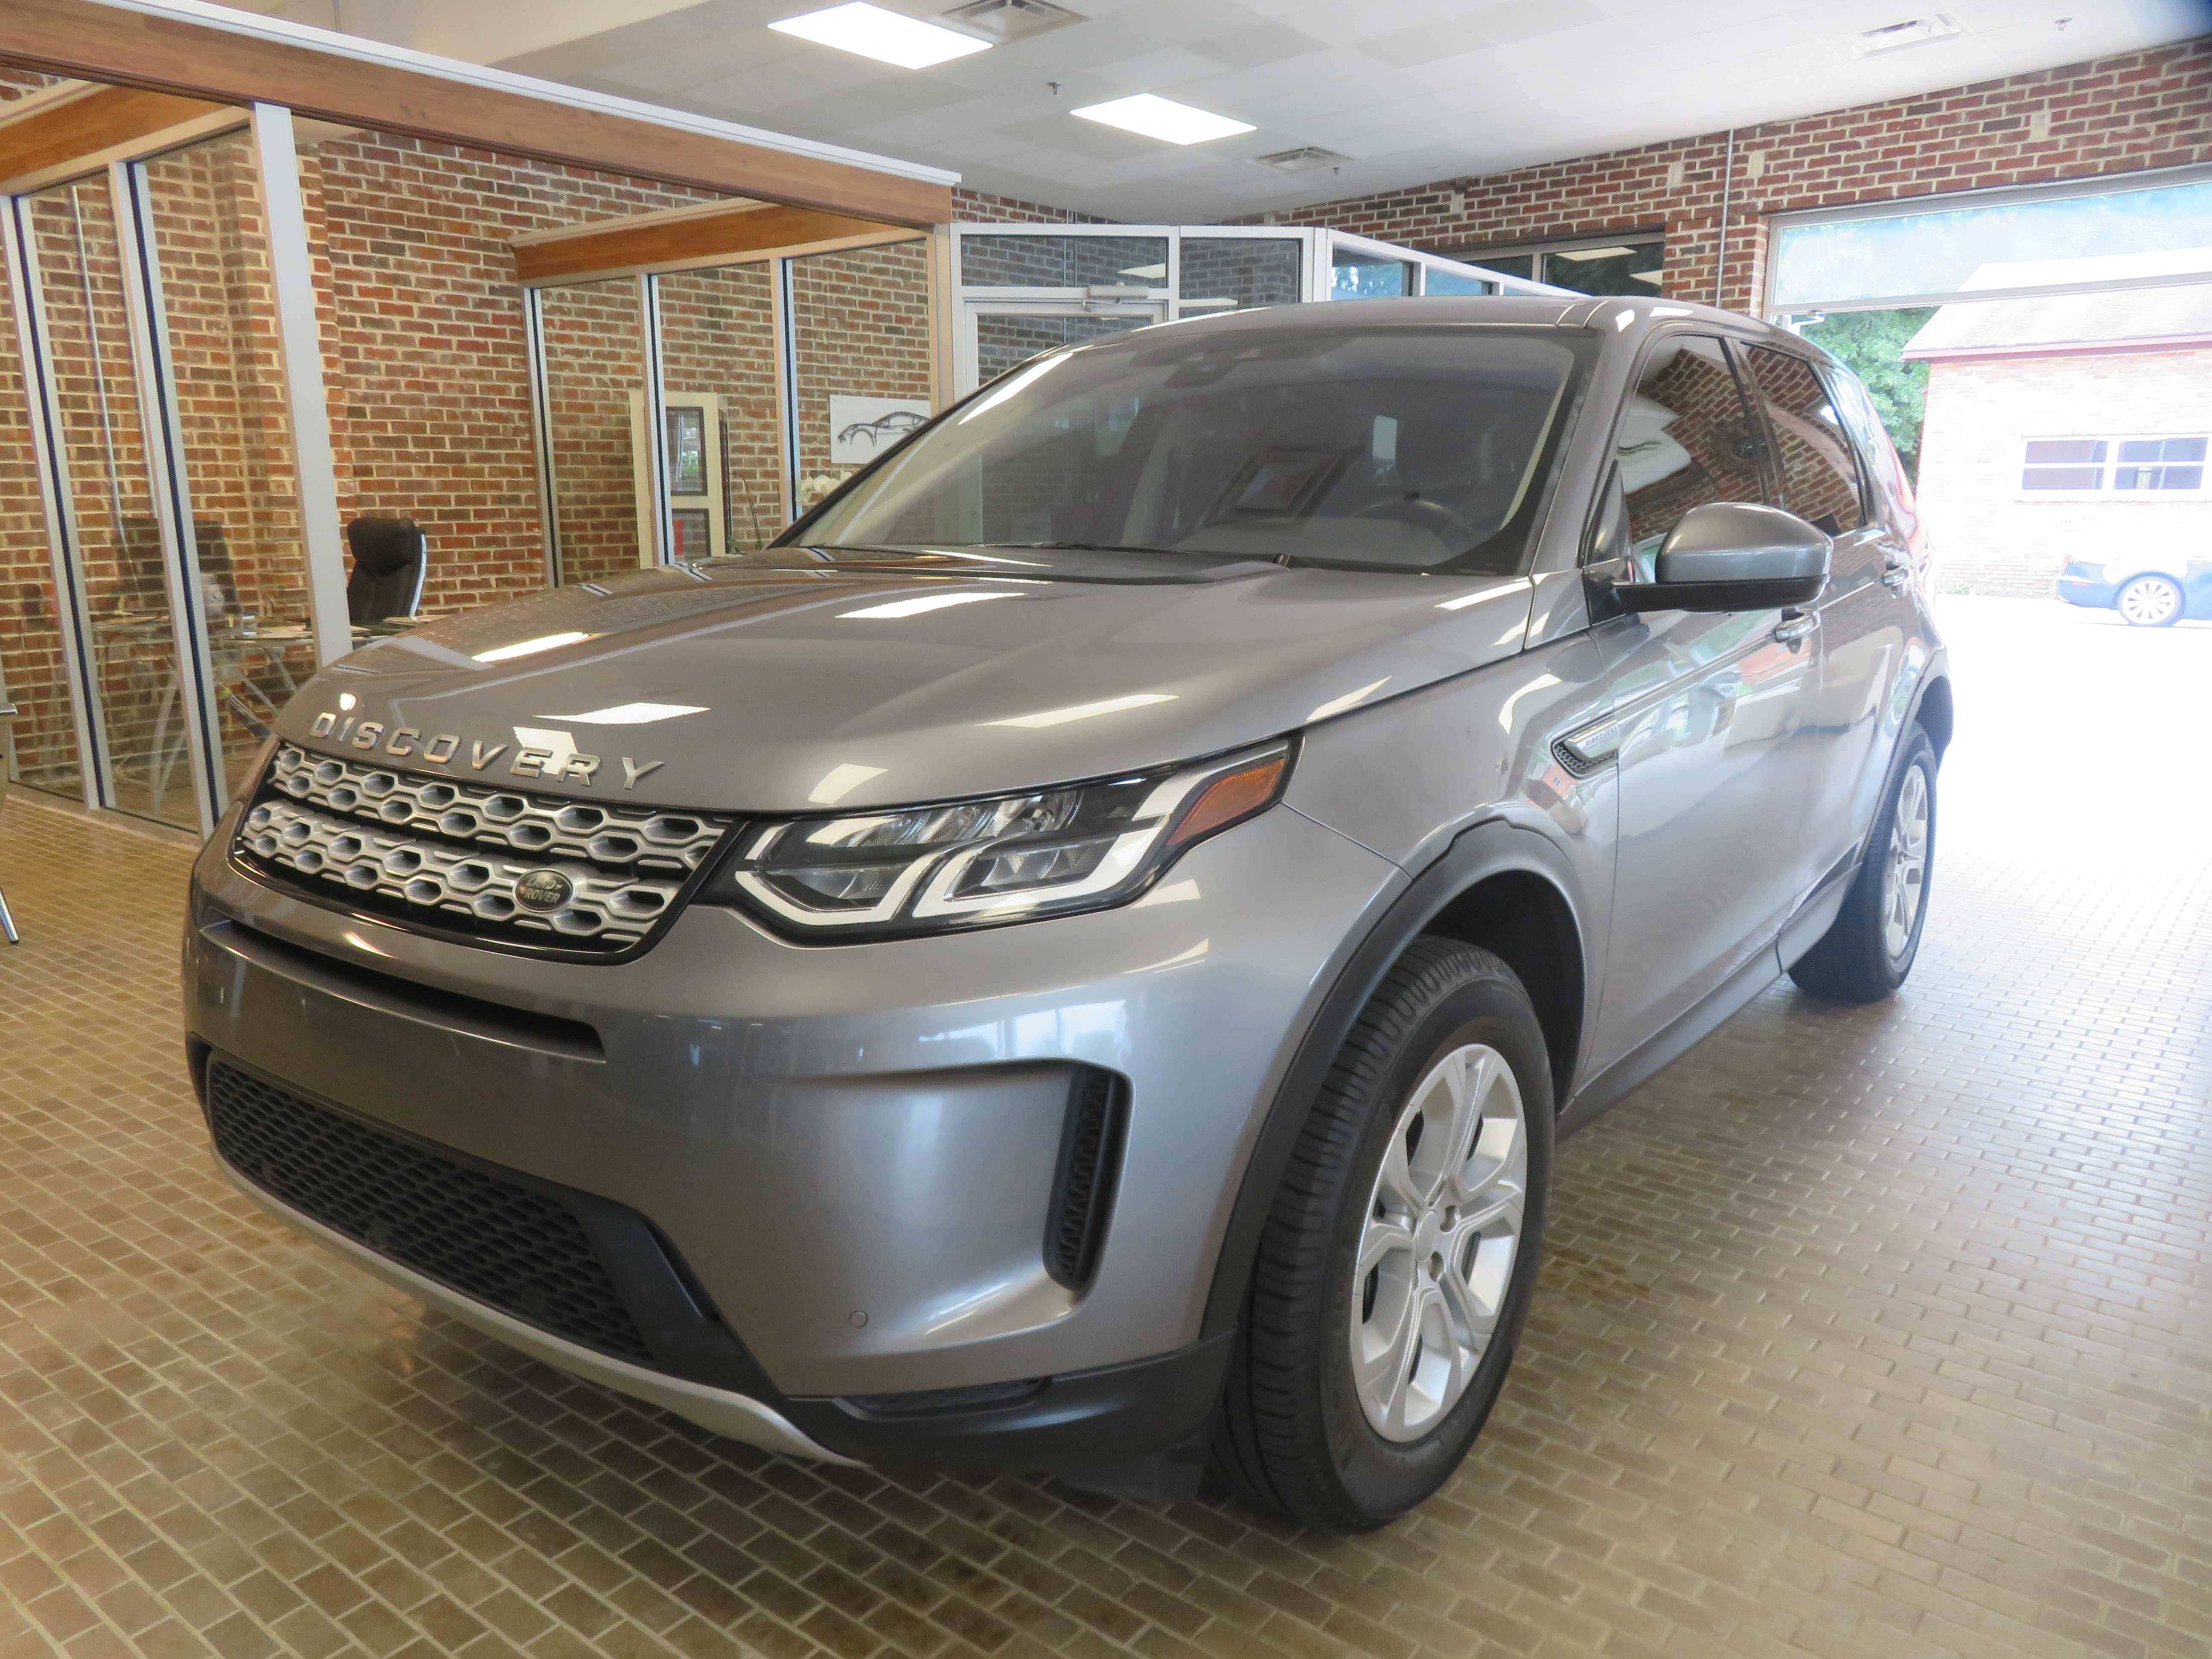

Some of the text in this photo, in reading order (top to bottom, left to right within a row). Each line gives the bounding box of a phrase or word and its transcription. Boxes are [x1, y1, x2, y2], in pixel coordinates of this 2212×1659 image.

[1585, 726, 1618, 746] DISCOVERY
[309, 712, 664, 790] DISCOVERY
[526, 876, 557, 890] LAND
[524, 888, 561, 904] ROVER
